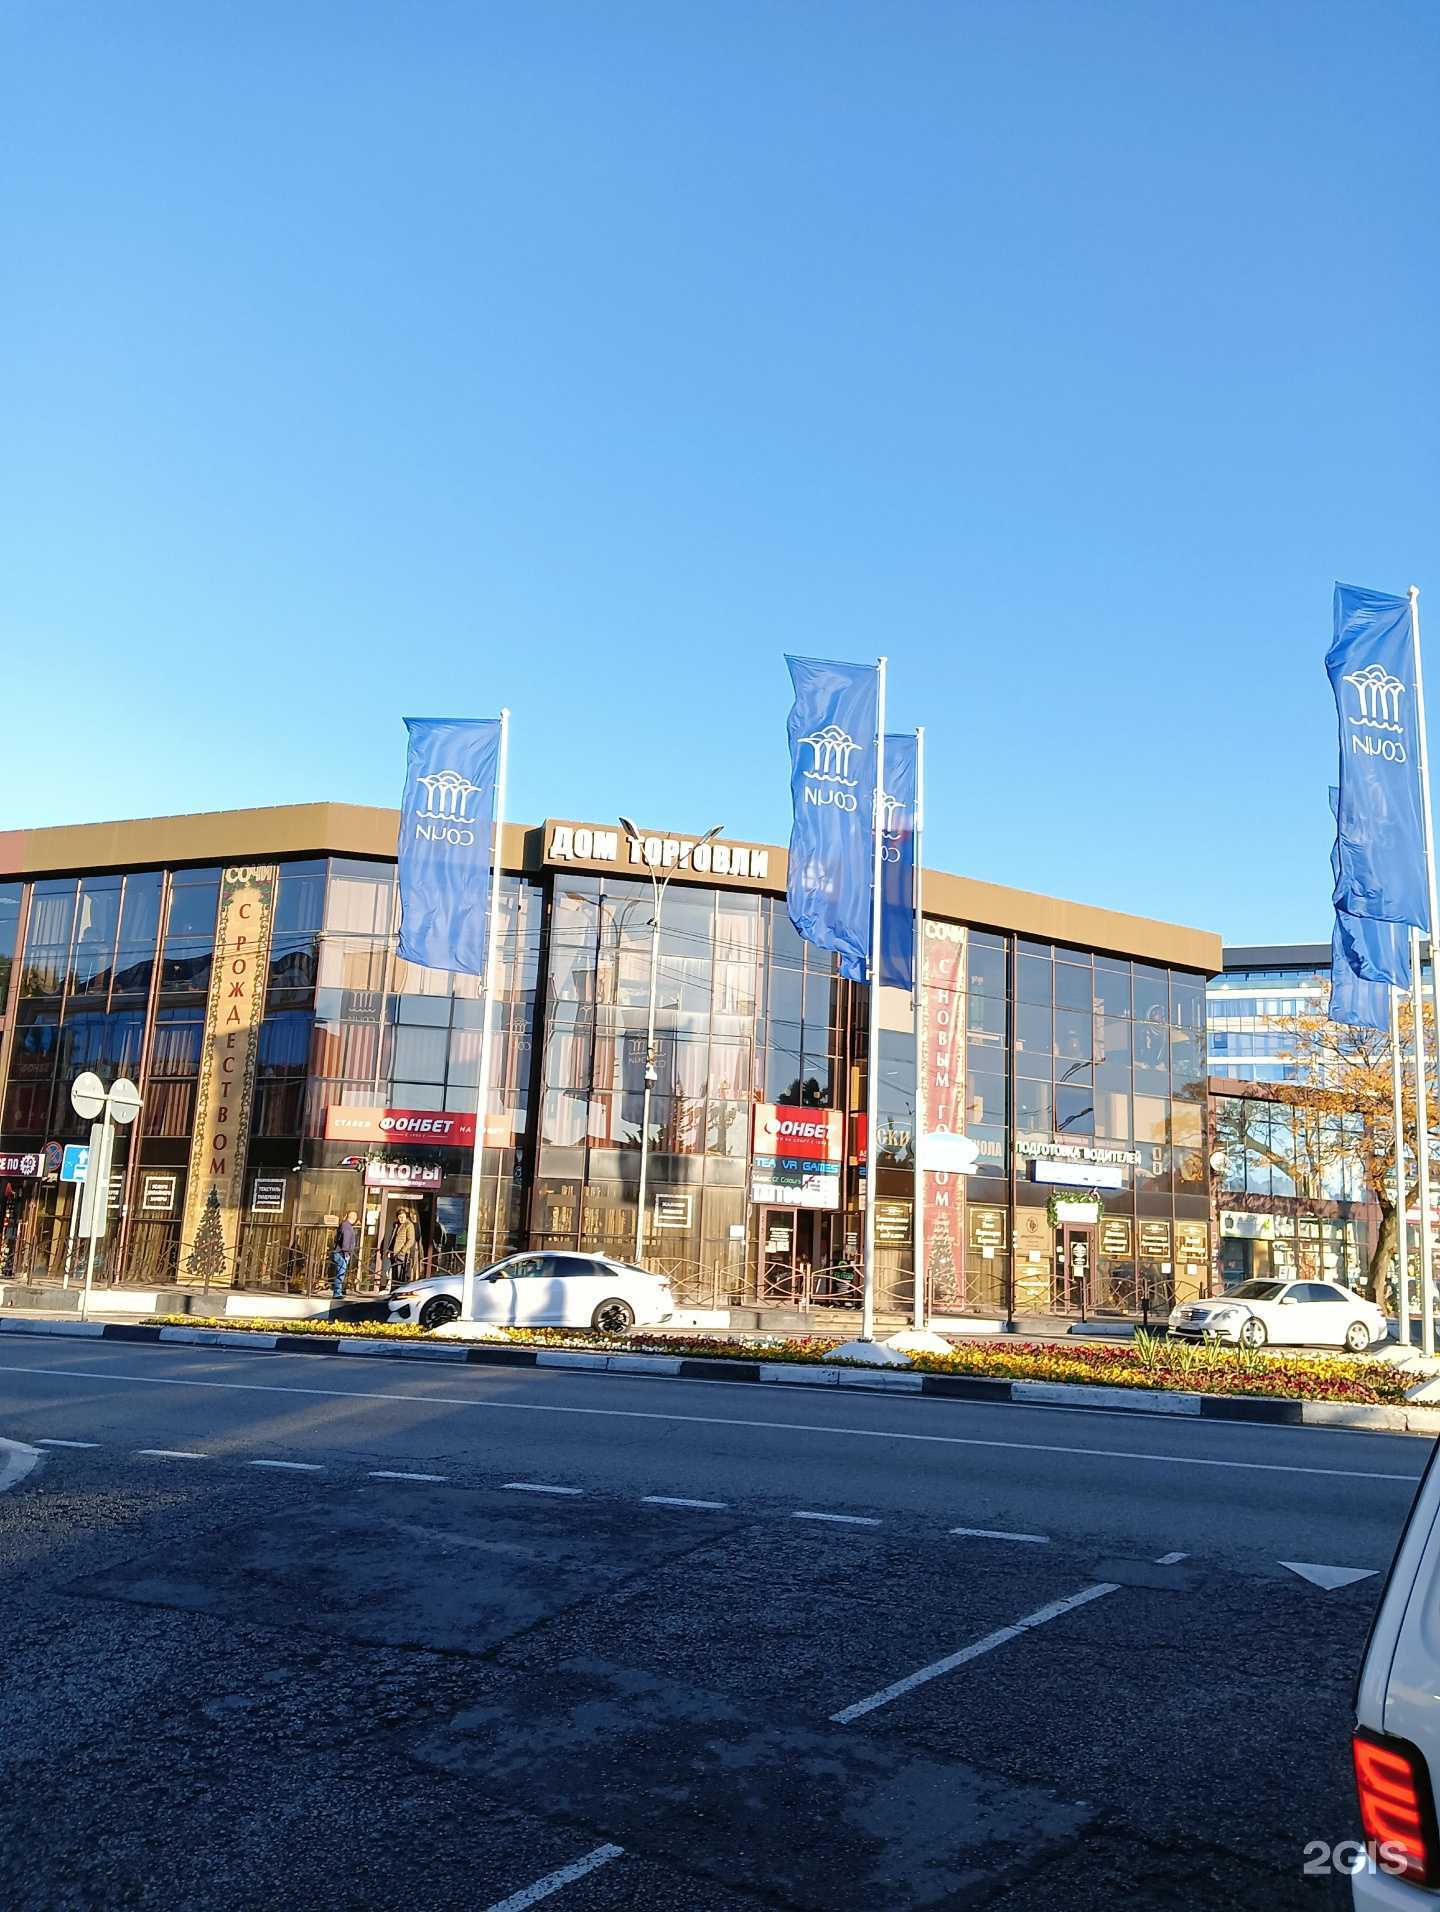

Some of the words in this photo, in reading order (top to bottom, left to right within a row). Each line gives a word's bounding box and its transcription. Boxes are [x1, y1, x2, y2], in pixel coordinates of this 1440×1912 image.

[549, 826, 618, 861] ДОМ
[626, 835, 769, 879] ТОРГОВЛИ
[226, 865, 273, 883] СОЧИ
[935, 990, 951, 1088] НОВЫМ
[208, 934, 248, 1175] РОЖДЕСТВОМ
[379, 1117, 454, 1134] ФОНБЕТ
[935, 1104, 950, 1207] ГООМ
[1016, 1140, 1084, 1160] ПОДГОТОВКА
[1084, 1147, 1142, 1165] ВОДИТЕЛЕЙ
[367, 1161, 439, 1180] ШТОРЫ
[755, 1157, 776, 1168] TEA
[782, 1160, 798, 1170] VR
[802, 1162, 839, 1174] GAMES
